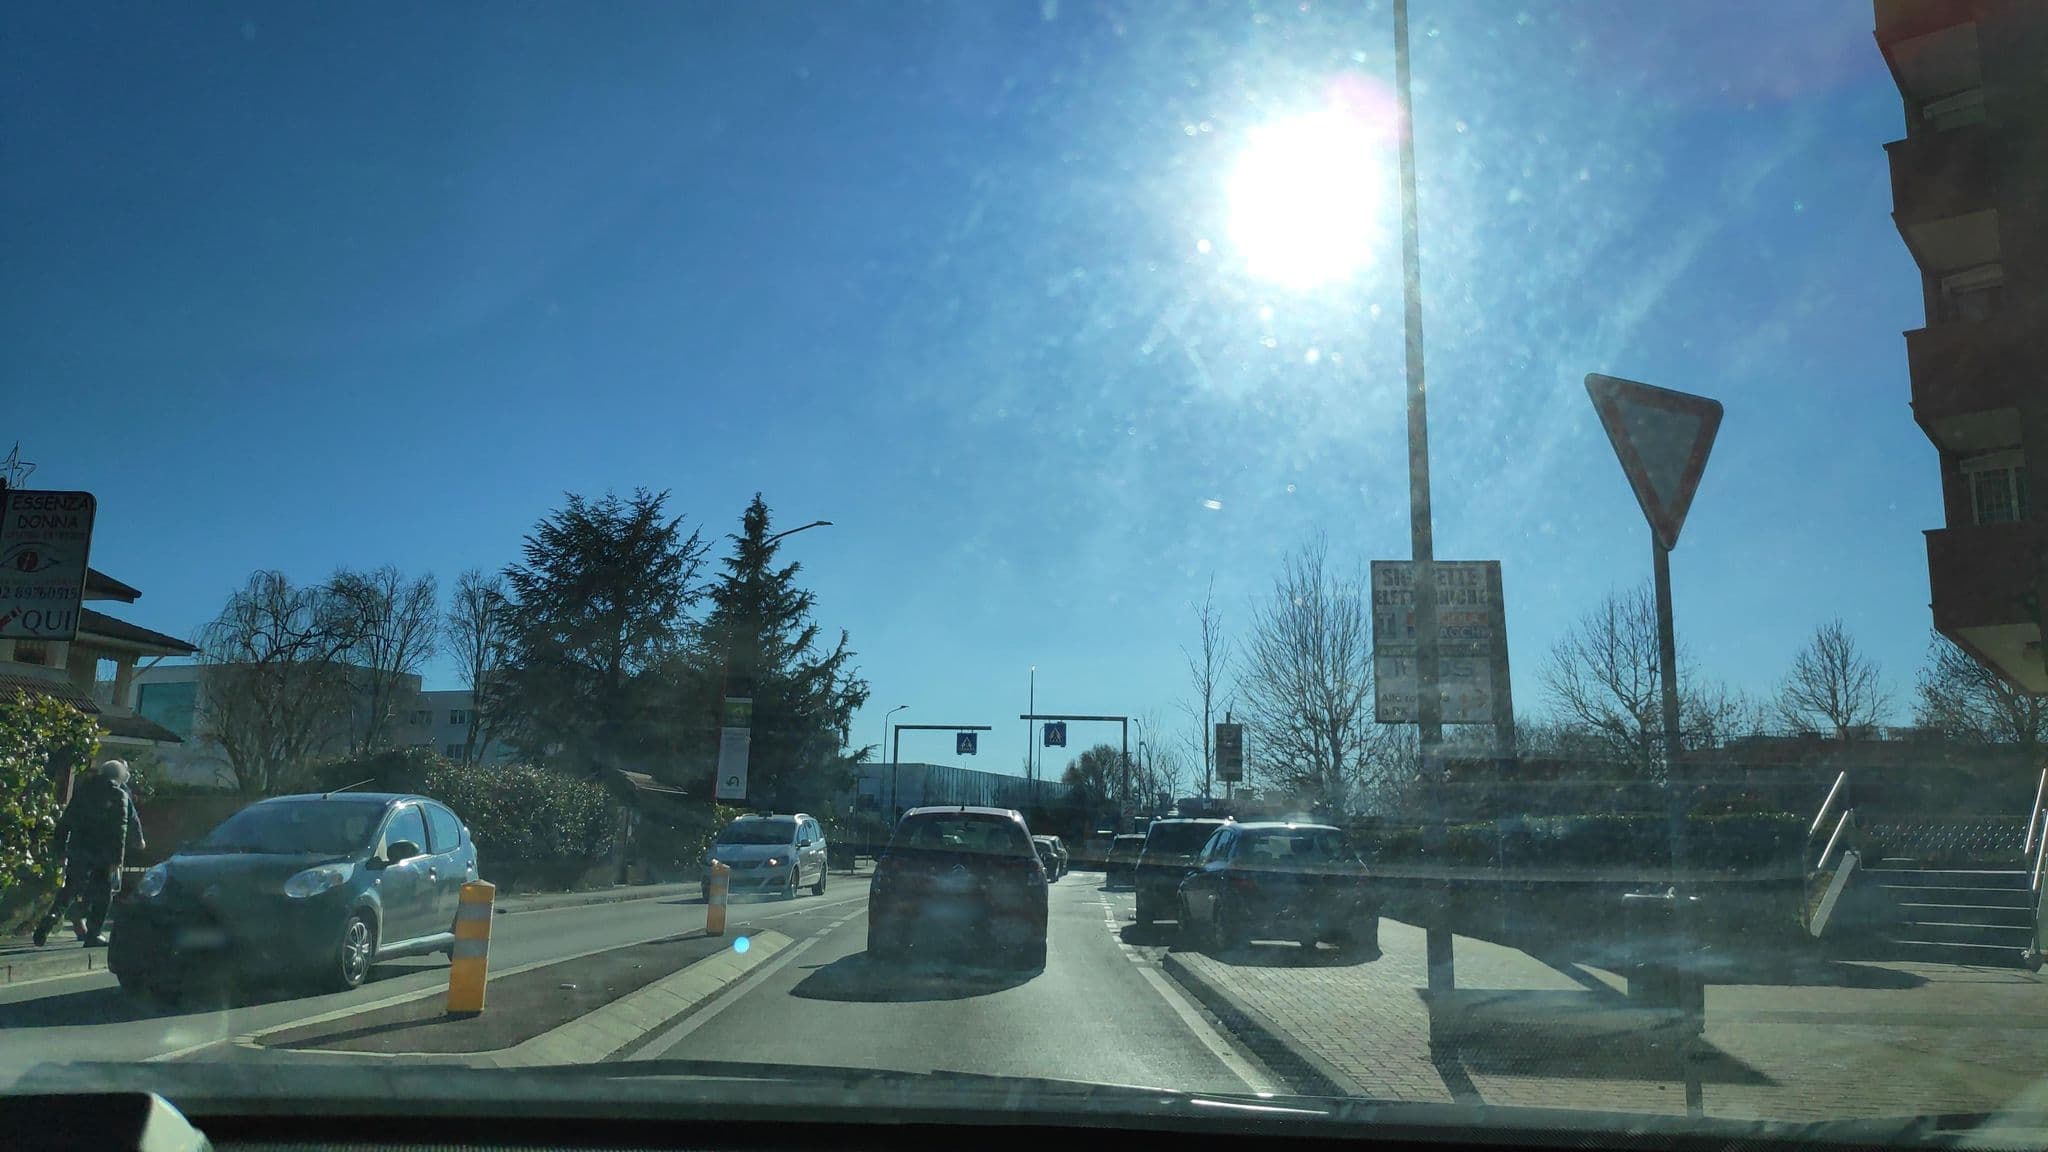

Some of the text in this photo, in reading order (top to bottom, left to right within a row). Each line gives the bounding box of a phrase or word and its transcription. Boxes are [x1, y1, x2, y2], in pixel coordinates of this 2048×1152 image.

[11, 495, 89, 511] ESSENZA
[17, 514, 79, 529] DONNA
[22, 608, 71, 635] QUI
